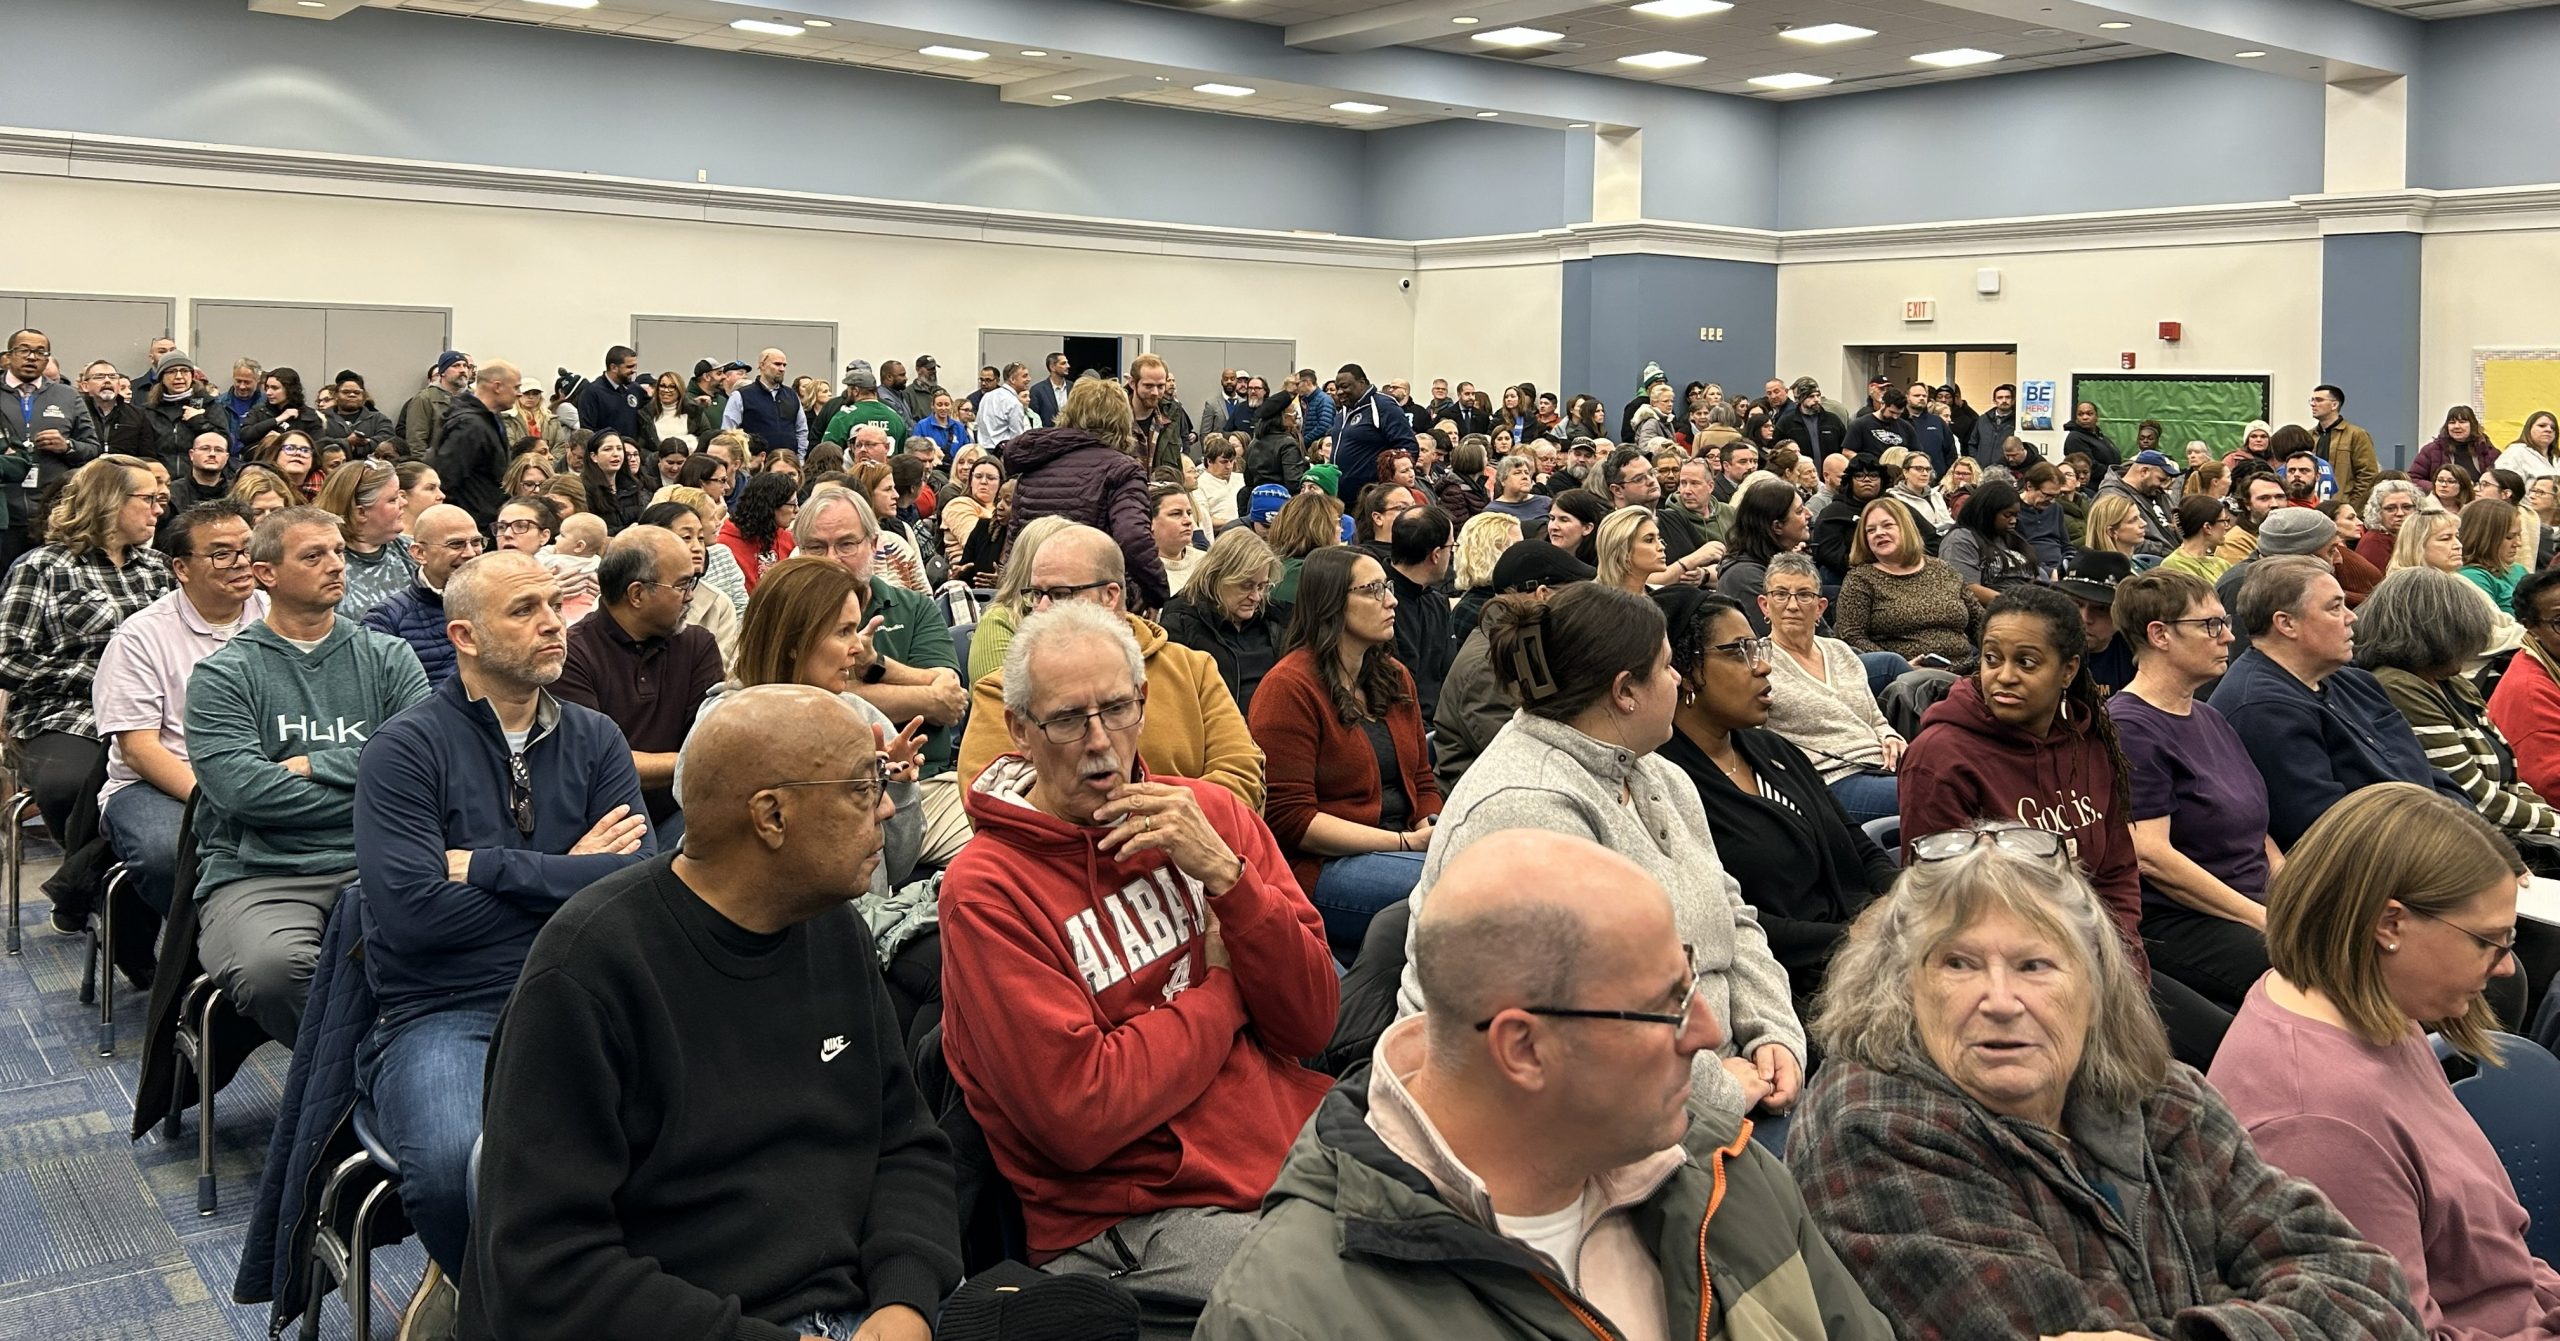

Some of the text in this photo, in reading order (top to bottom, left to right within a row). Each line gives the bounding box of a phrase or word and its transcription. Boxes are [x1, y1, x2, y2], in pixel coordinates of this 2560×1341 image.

[1907, 302, 1927, 318] EXIT
[2026, 386, 2051, 401] BE
[2026, 405, 2049, 413] HERO
[2017, 789, 2103, 832] God is.
[823, 1035, 844, 1052] NIKE
